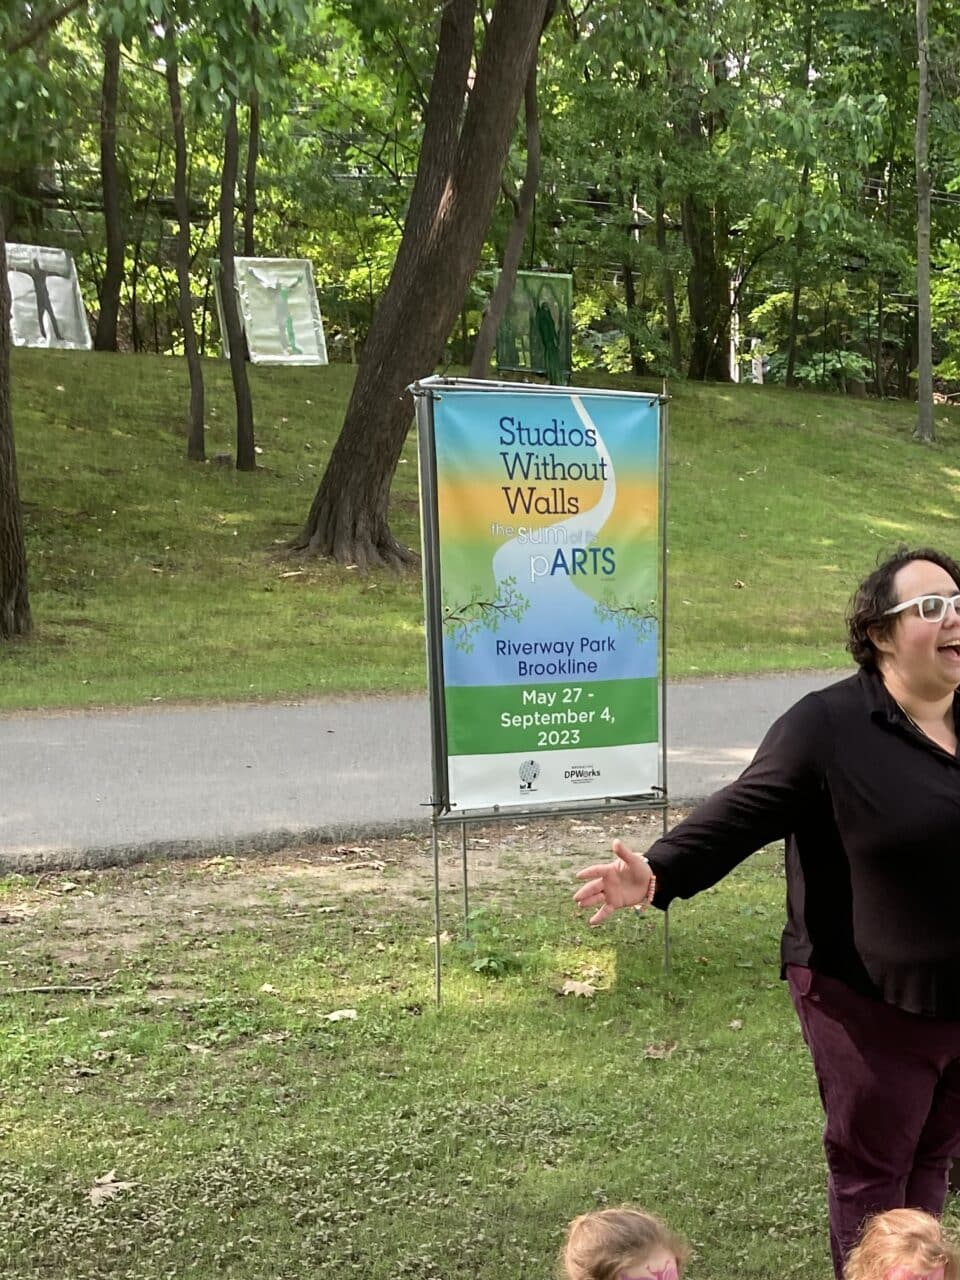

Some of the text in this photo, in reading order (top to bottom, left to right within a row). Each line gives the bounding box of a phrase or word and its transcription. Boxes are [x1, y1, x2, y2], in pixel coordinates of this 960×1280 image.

[499, 416, 597, 447] Studios
[499, 452, 608, 481] Without
[502, 486, 580, 515] Walls
[491, 522, 514, 537] the
[518, 525, 567, 545] sum
[530, 547, 616, 583] pARTS
[496, 636, 616, 656] Riverway Park
[518, 659, 598, 676] Brookline
[522, 690, 557, 707] May
[562, 687, 583, 703] 27
[501, 706, 616, 730] September 4,
[537, 729, 581, 746] 2023
[564, 768, 601, 779] DPWorks
